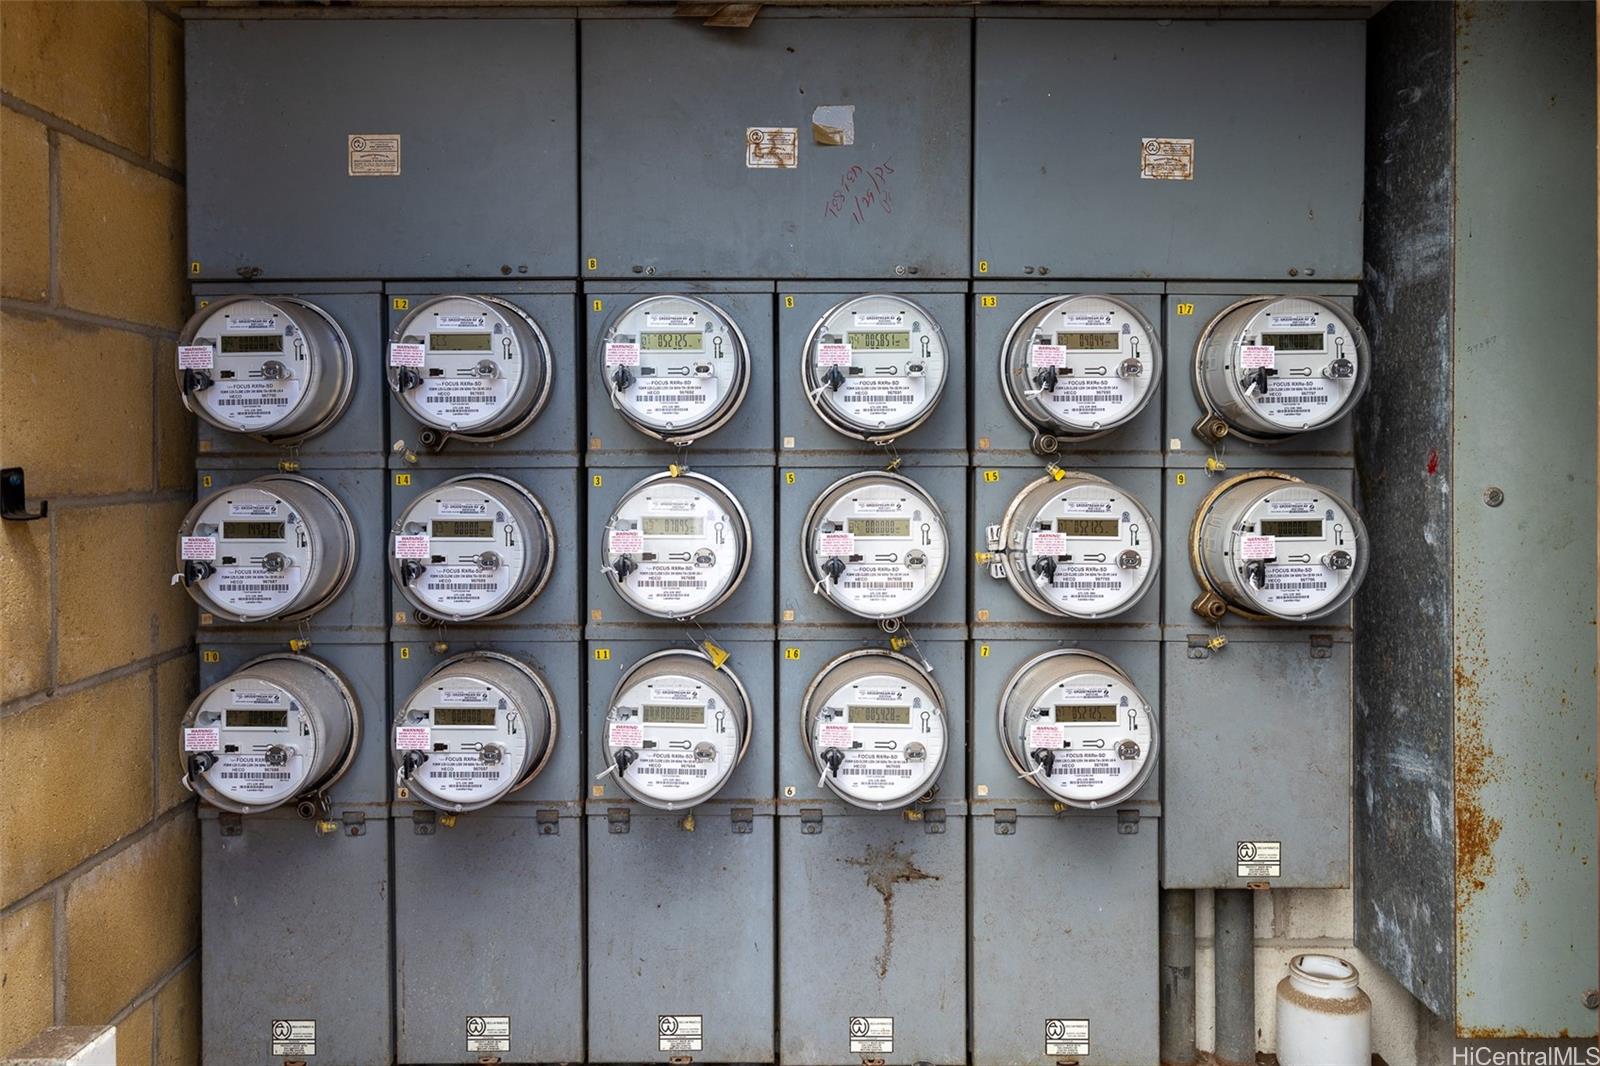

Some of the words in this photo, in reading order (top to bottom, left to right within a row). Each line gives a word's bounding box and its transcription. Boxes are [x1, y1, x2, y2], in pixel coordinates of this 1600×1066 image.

[396, 300, 407, 309] 12
[984, 298, 995, 306] 13
[1180, 305, 1193, 314] 17
[397, 476, 408, 485] 14
[986, 472, 998, 481] 15
[206, 652, 218, 661] 10
[597, 651, 608, 659] 11
[787, 650, 799, 659] 16
